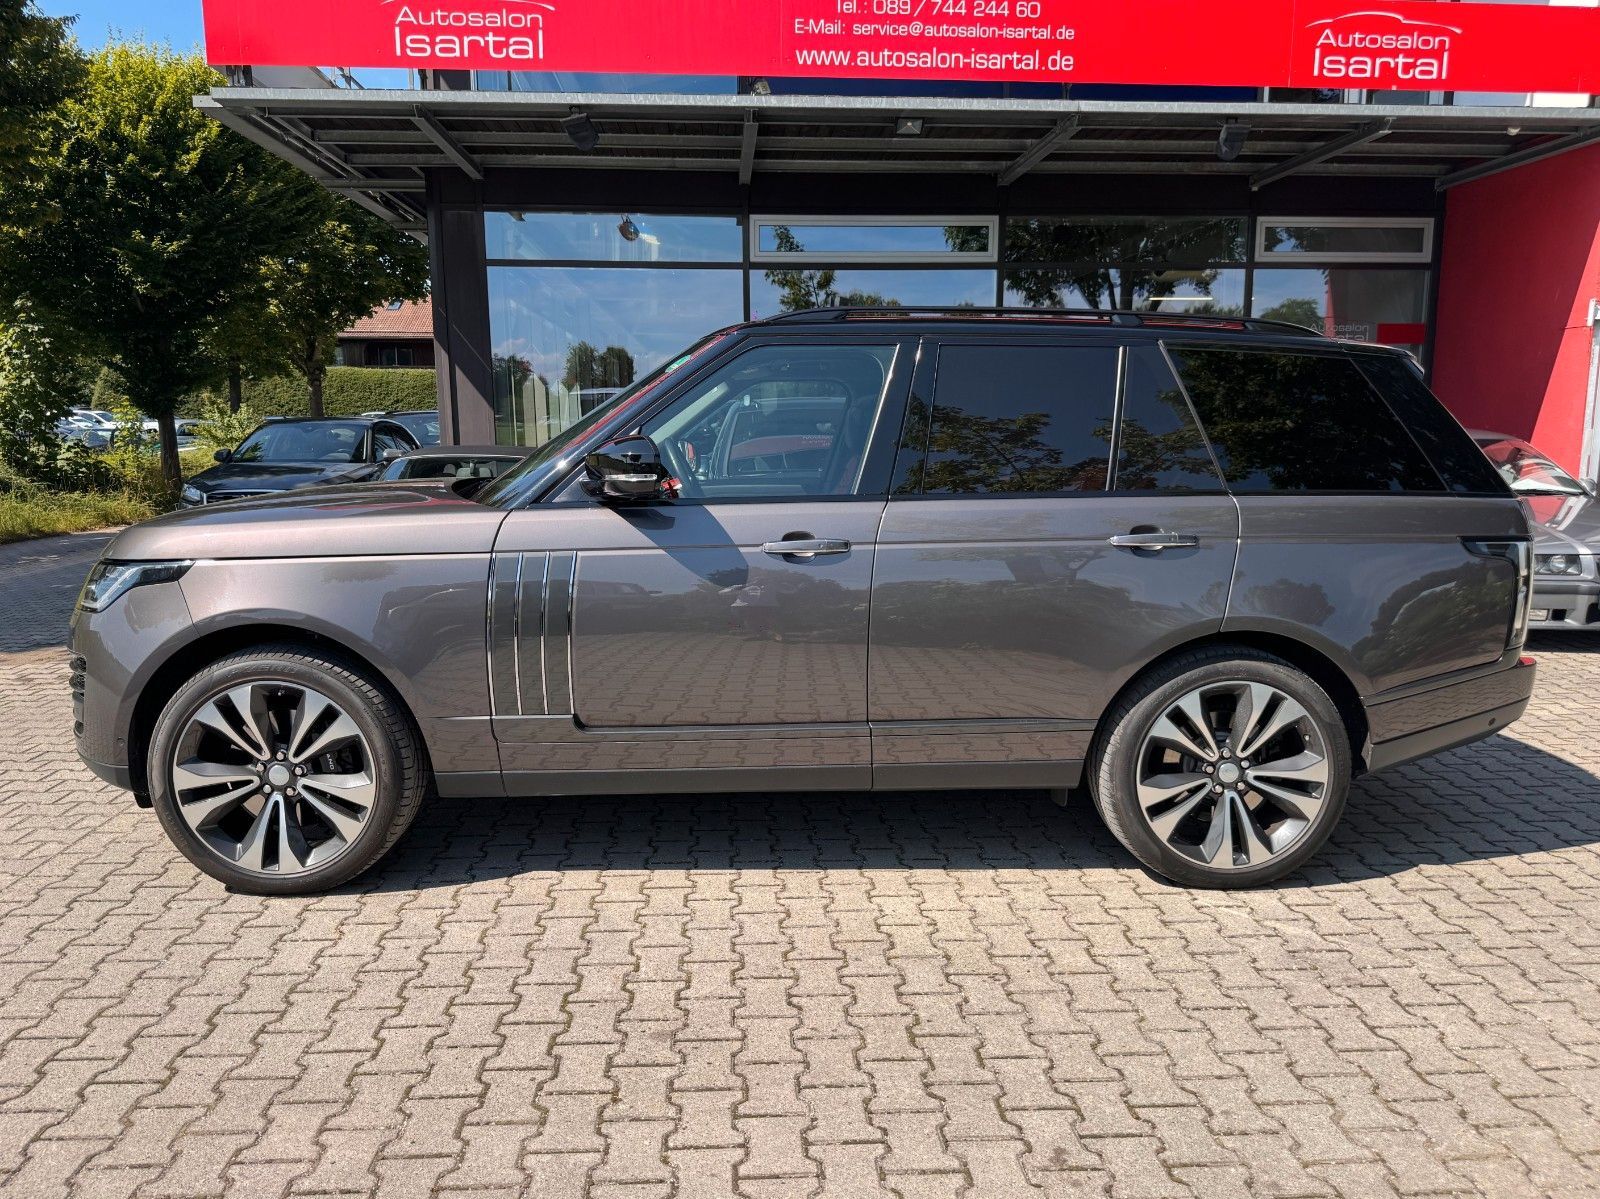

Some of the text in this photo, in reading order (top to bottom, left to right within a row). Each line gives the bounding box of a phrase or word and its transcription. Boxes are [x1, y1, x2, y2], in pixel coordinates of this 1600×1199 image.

[395, 6, 543, 28] Autosalon
[836, 0, 1041, 18] Tel.: 089 / 744 244 60
[794, 19, 1075, 40] E-Mail: service@autosalon-isartal.de
[1316, 28, 1450, 50] Autosalon
[394, 26, 544, 59] Isartal
[795, 48, 1074, 71] www.autosalon-isartal.de
[1313, 48, 1449, 80] Isartal
